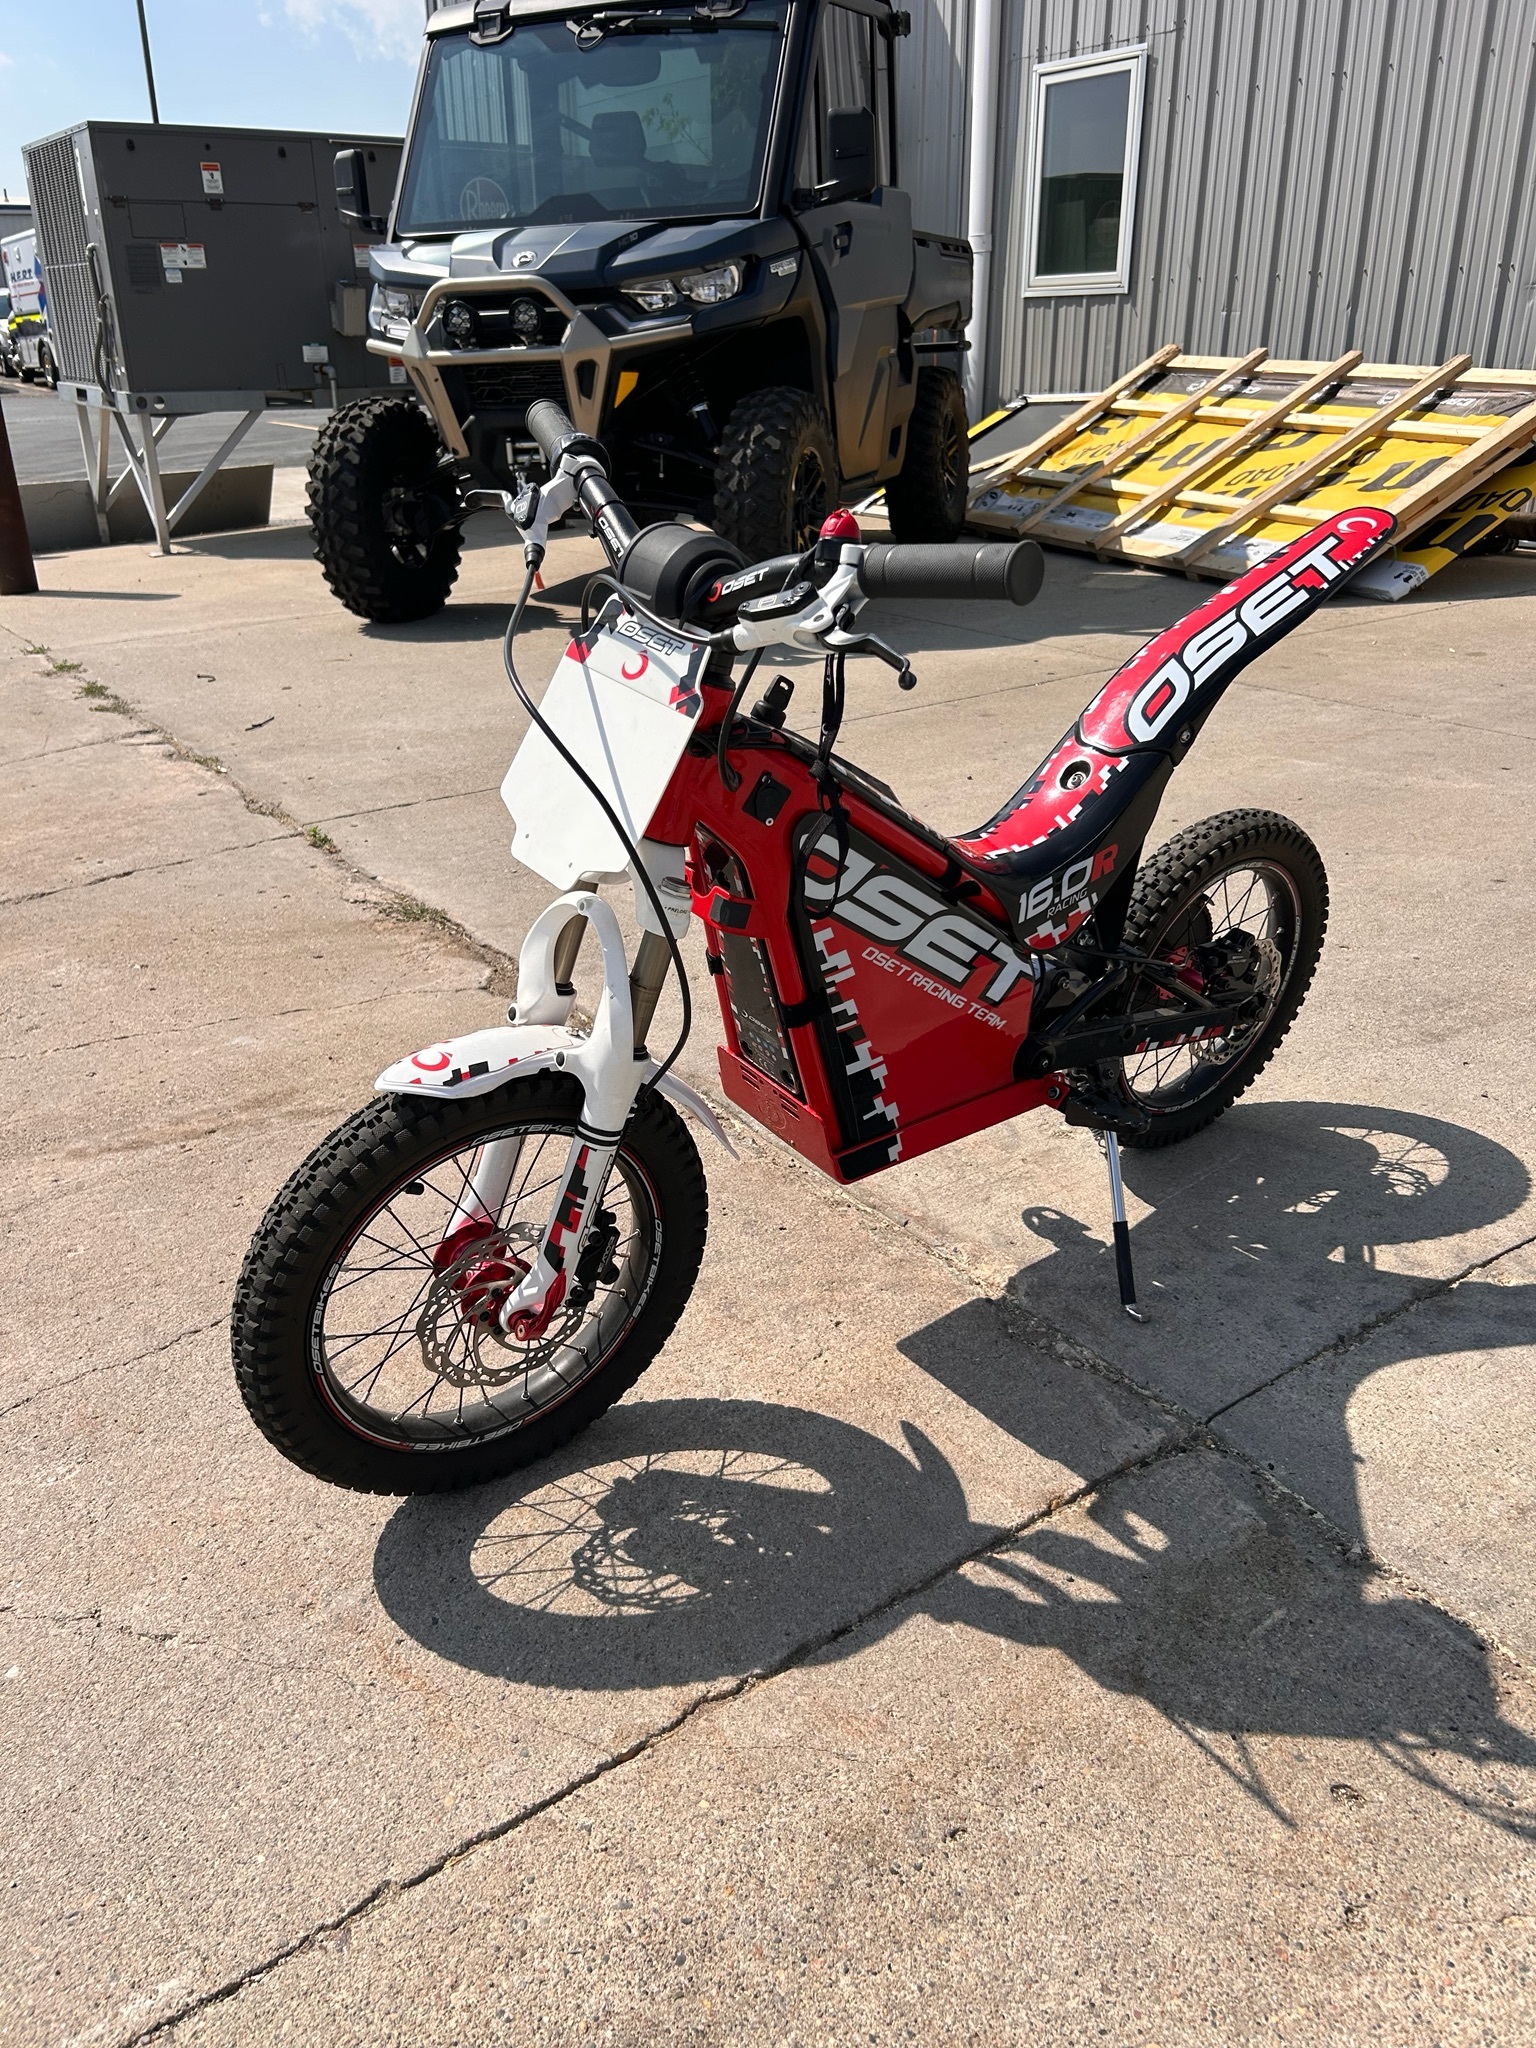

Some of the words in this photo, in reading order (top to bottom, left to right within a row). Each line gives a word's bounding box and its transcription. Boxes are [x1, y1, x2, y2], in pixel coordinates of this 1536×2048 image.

[598, 517, 625, 558] OSET
[721, 567, 770, 596] OSET
[617, 621, 686, 656] OSET
[1128, 535, 1342, 742] OSET
[1018, 843, 1118, 924] 16.0R
[1047, 887, 1087, 918] RACING
[800, 833, 1034, 1003] OSET
[861, 946, 912, 977] OSET
[908, 971, 967, 1009] RACING
[967, 1002, 1007, 1030] TEAM
[470, 1124, 577, 1147] OSETBIKE
[632, 1219, 662, 1319] OSETBIKES
[311, 1262, 341, 1374] OSETBIKES
[413, 1419, 524, 1450] OSETBIKES
